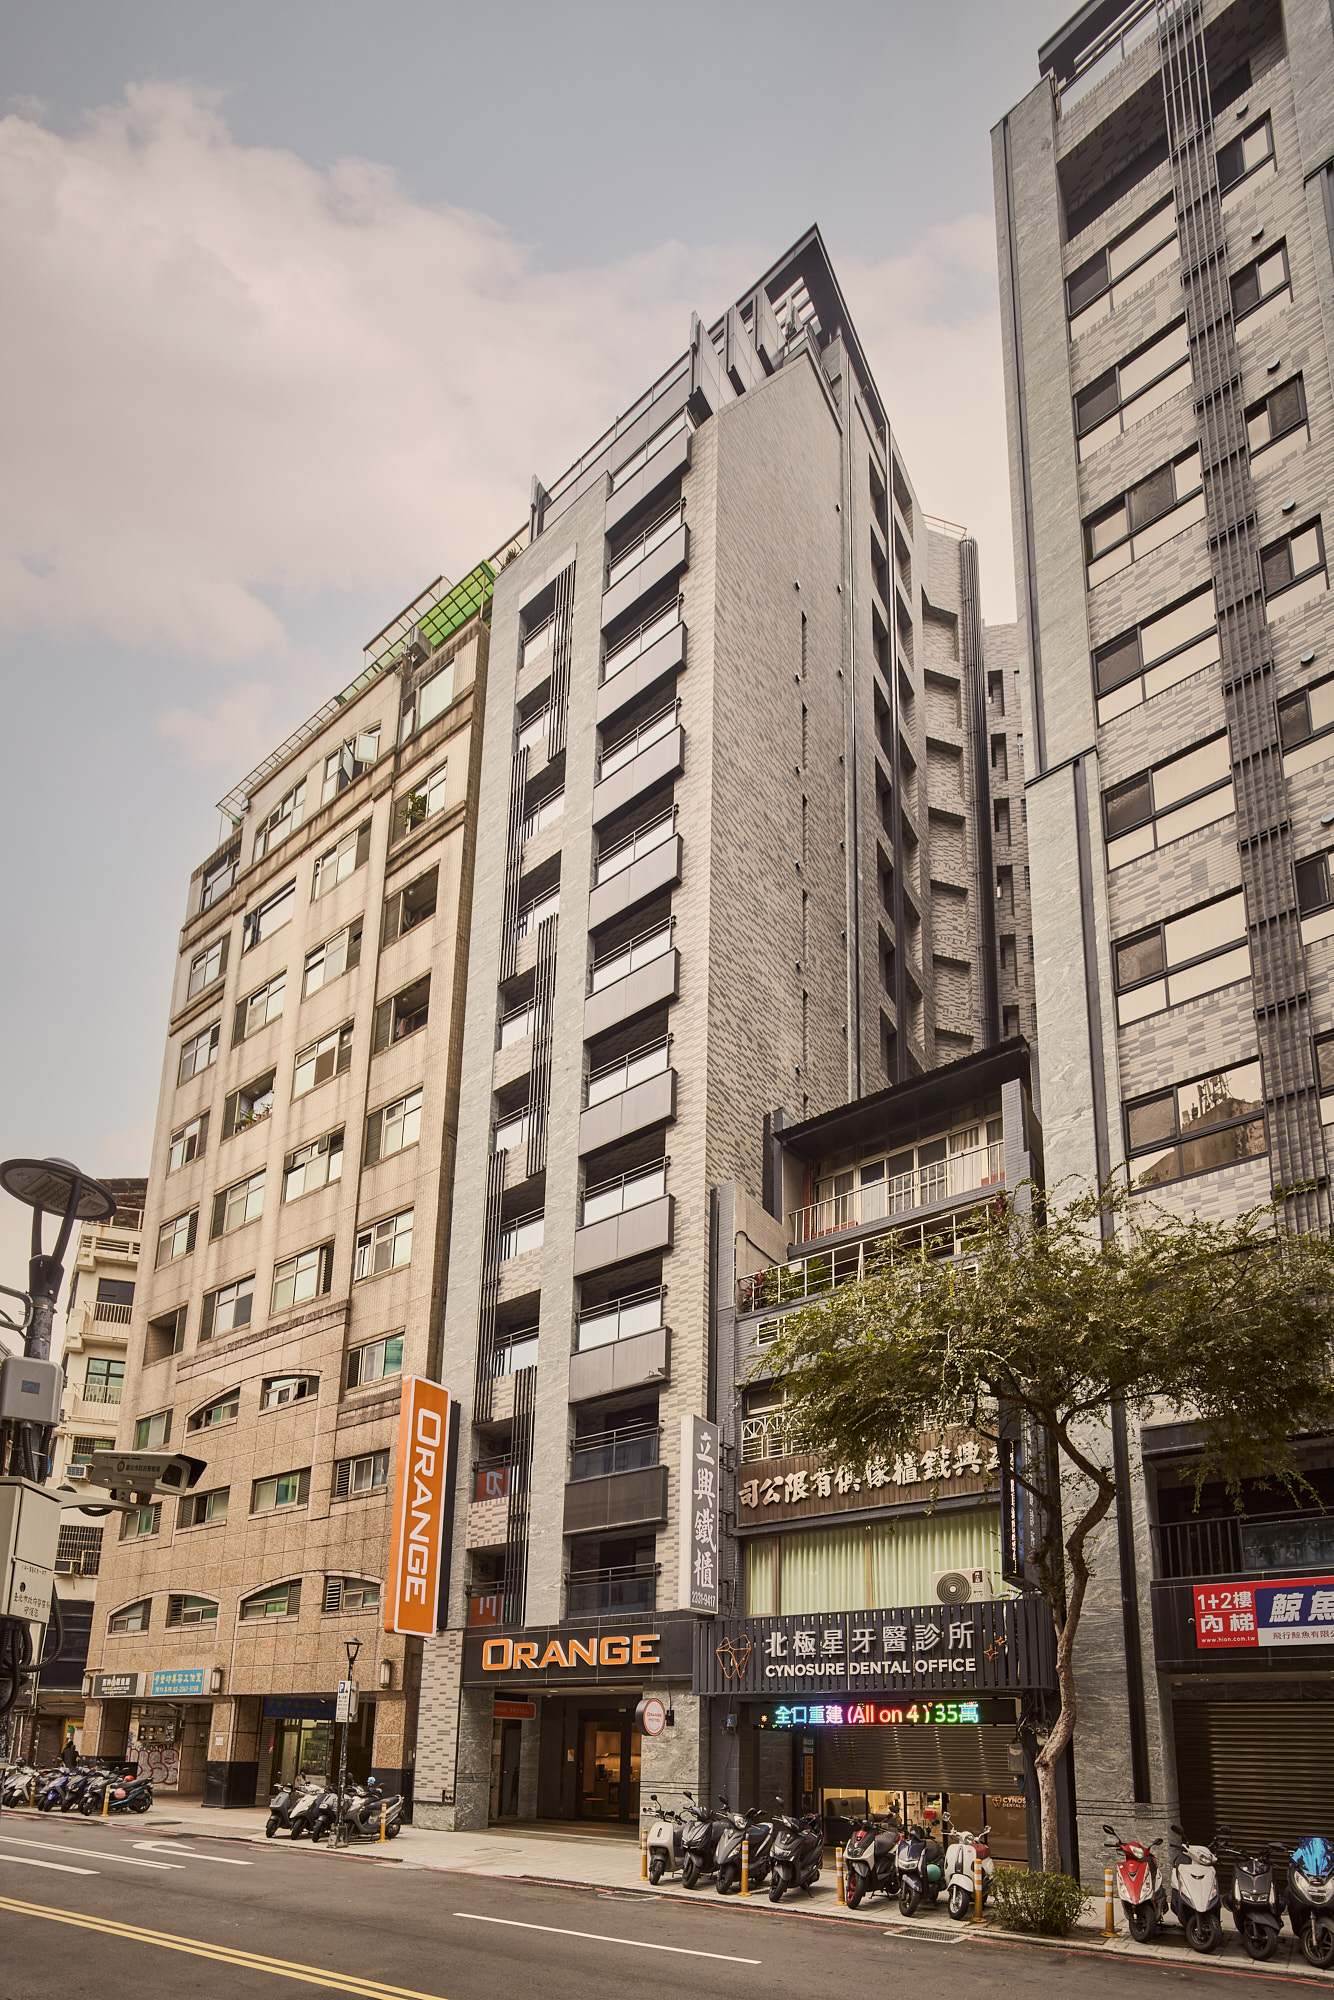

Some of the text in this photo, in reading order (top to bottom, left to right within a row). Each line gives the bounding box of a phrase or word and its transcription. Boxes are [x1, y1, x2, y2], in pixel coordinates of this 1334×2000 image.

[404, 1407, 442, 1605] ORANGE
[693, 1431, 717, 1590] 立興鐵櫃
[691, 1590, 716, 1608] 2331-9417
[1197, 1591, 1253, 1610] 1+2樓
[765, 1621, 975, 1659] 北極星牙醫診所
[482, 1634, 660, 1670] ORANGE
[765, 1657, 976, 1678] CYNOSURE DENTAL OFFICE
[879, 1708, 903, 1723] on
[1002, 1796, 1026, 1804] CYNOS
